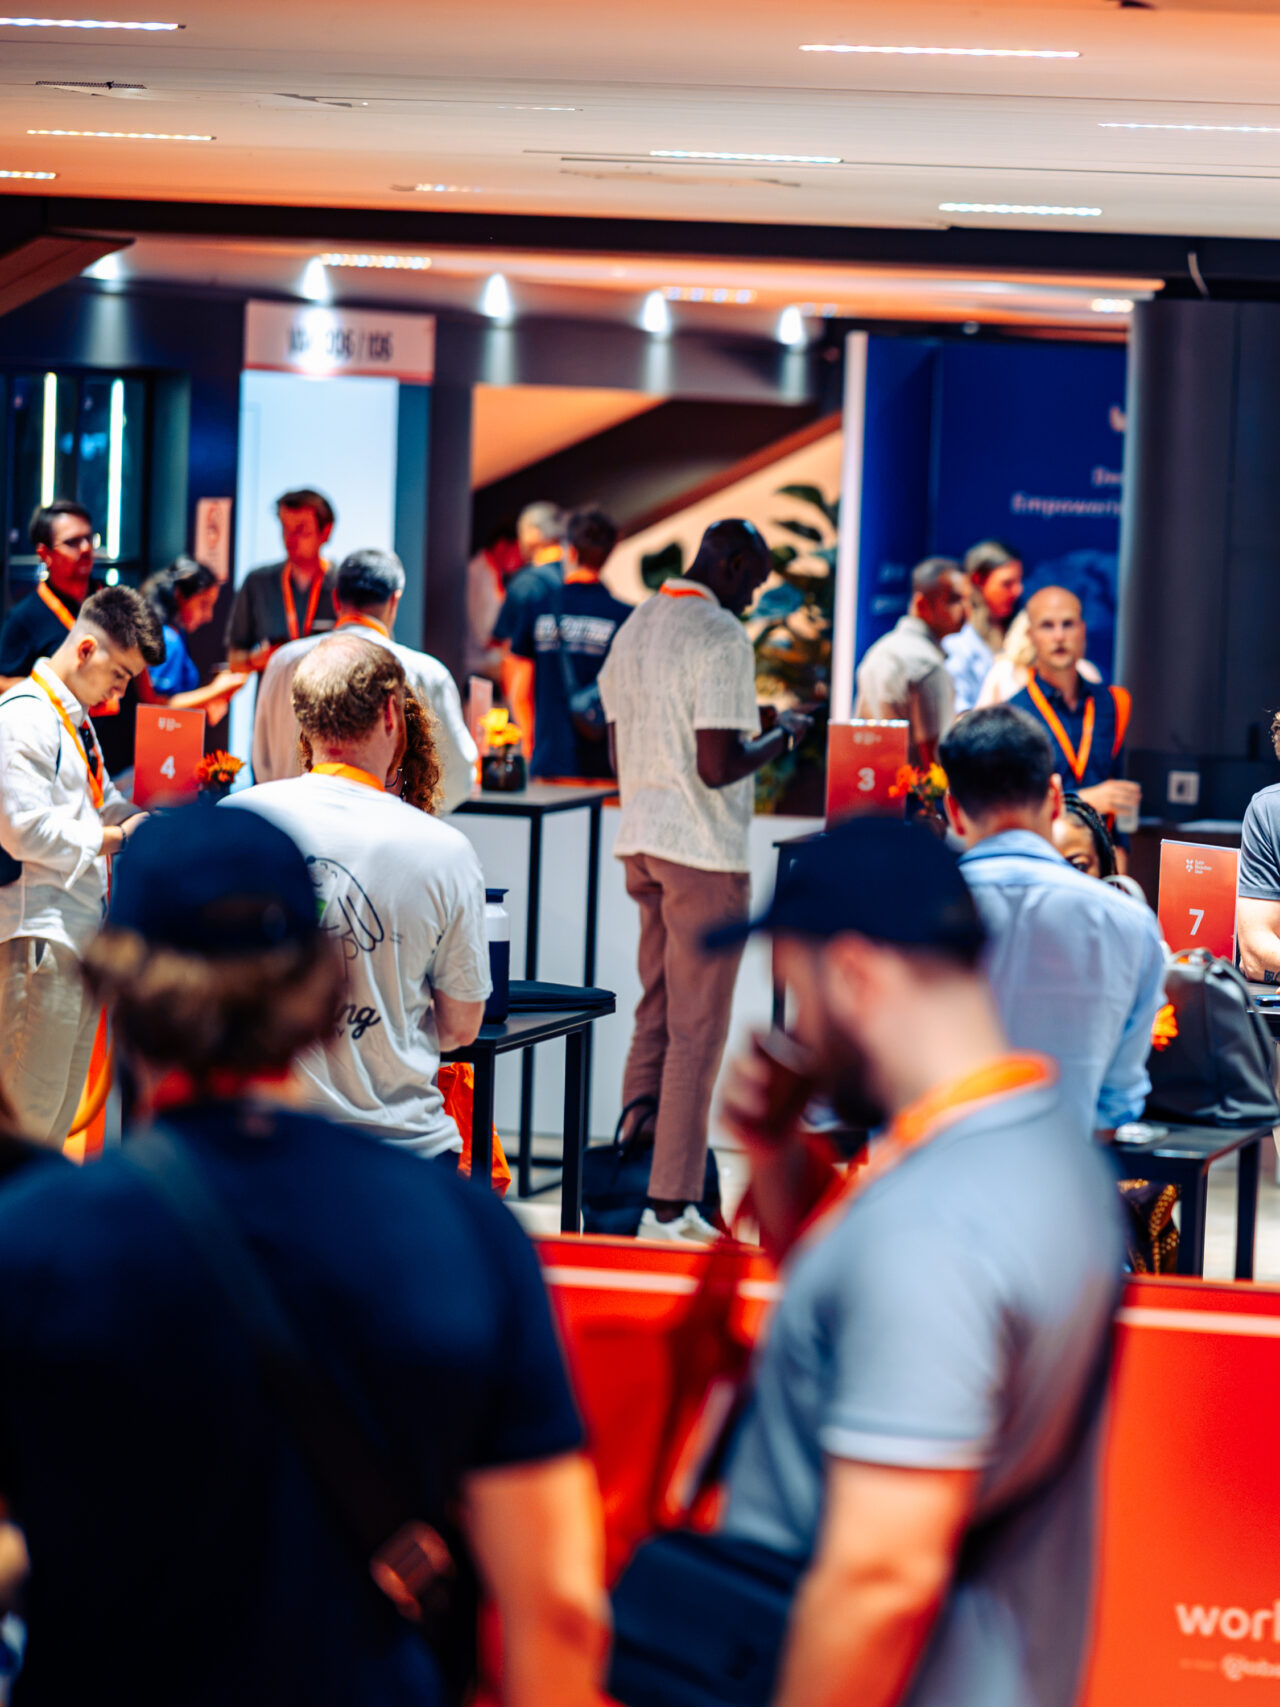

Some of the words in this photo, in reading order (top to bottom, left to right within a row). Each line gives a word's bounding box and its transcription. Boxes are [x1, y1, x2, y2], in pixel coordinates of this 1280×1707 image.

[160, 756, 175, 779] 4
[858, 767, 875, 791] 3
[1189, 908, 1205, 935] 7
